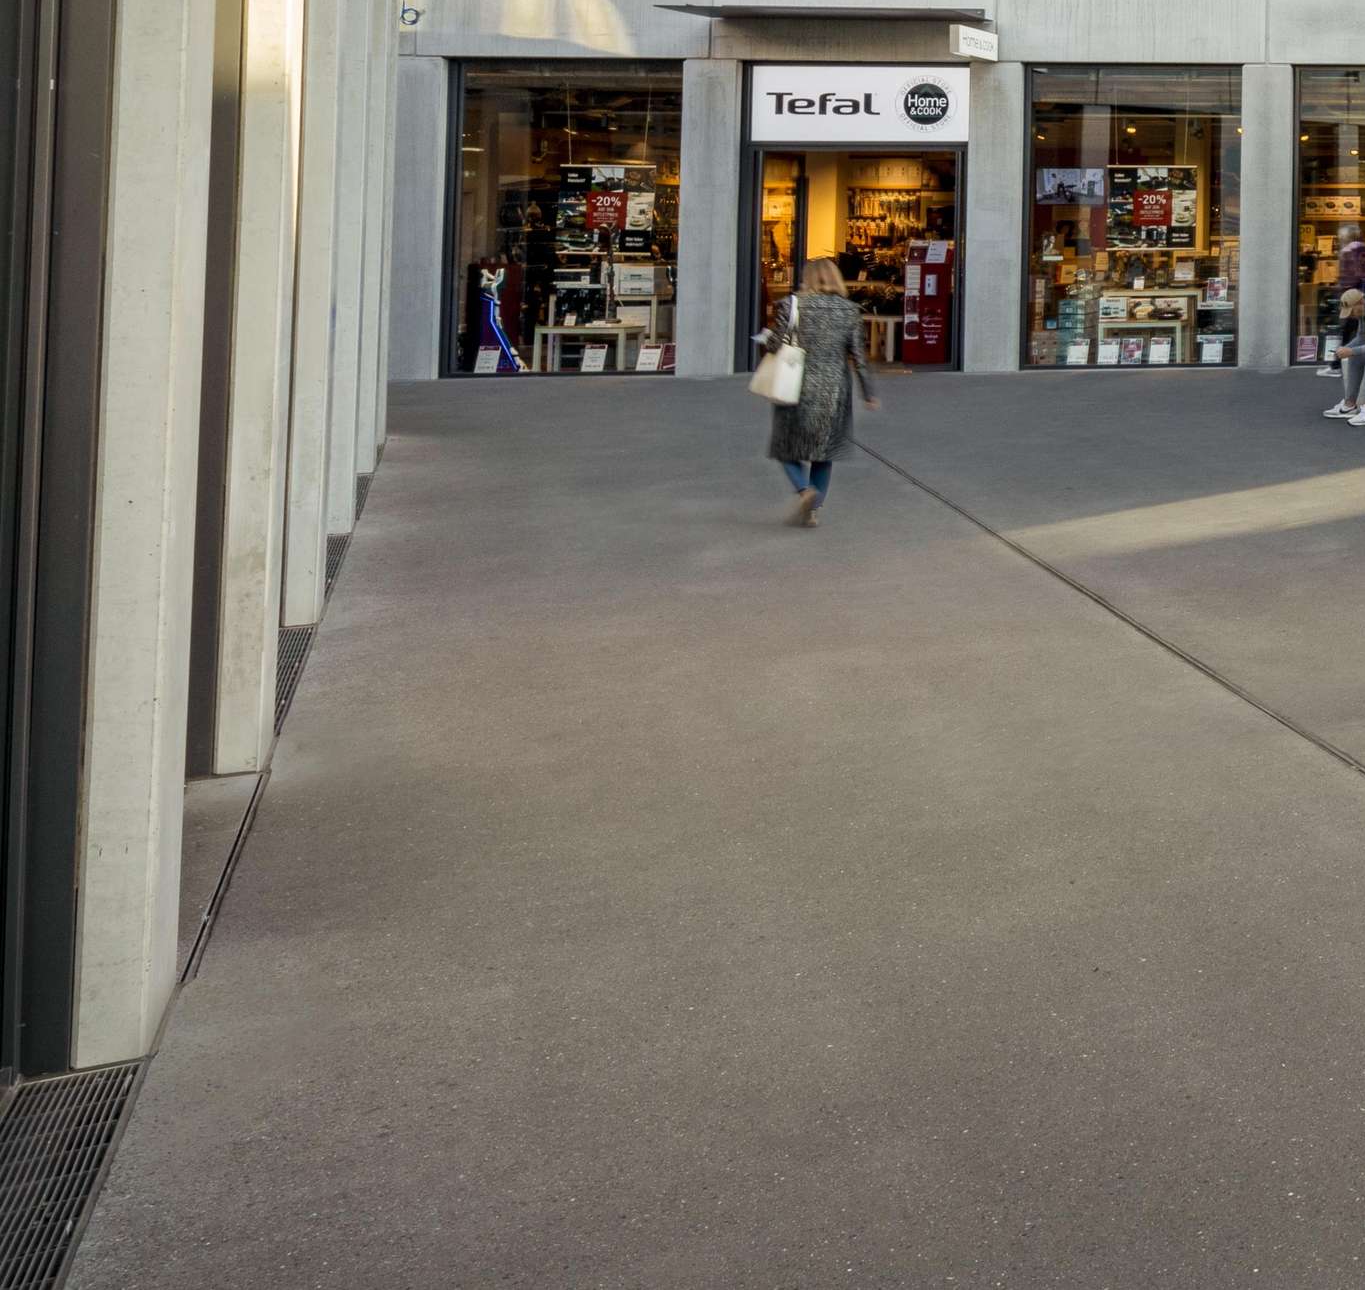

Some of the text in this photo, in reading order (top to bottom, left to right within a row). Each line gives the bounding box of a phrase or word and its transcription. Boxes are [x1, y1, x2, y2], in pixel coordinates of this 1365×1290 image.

[766, 92, 880, 115] Tefal
[907, 94, 947, 107] Home
[910, 107, 943, 115] &COOK
[591, 196, 621, 207] -20%
[1138, 194, 1167, 205] -20%
